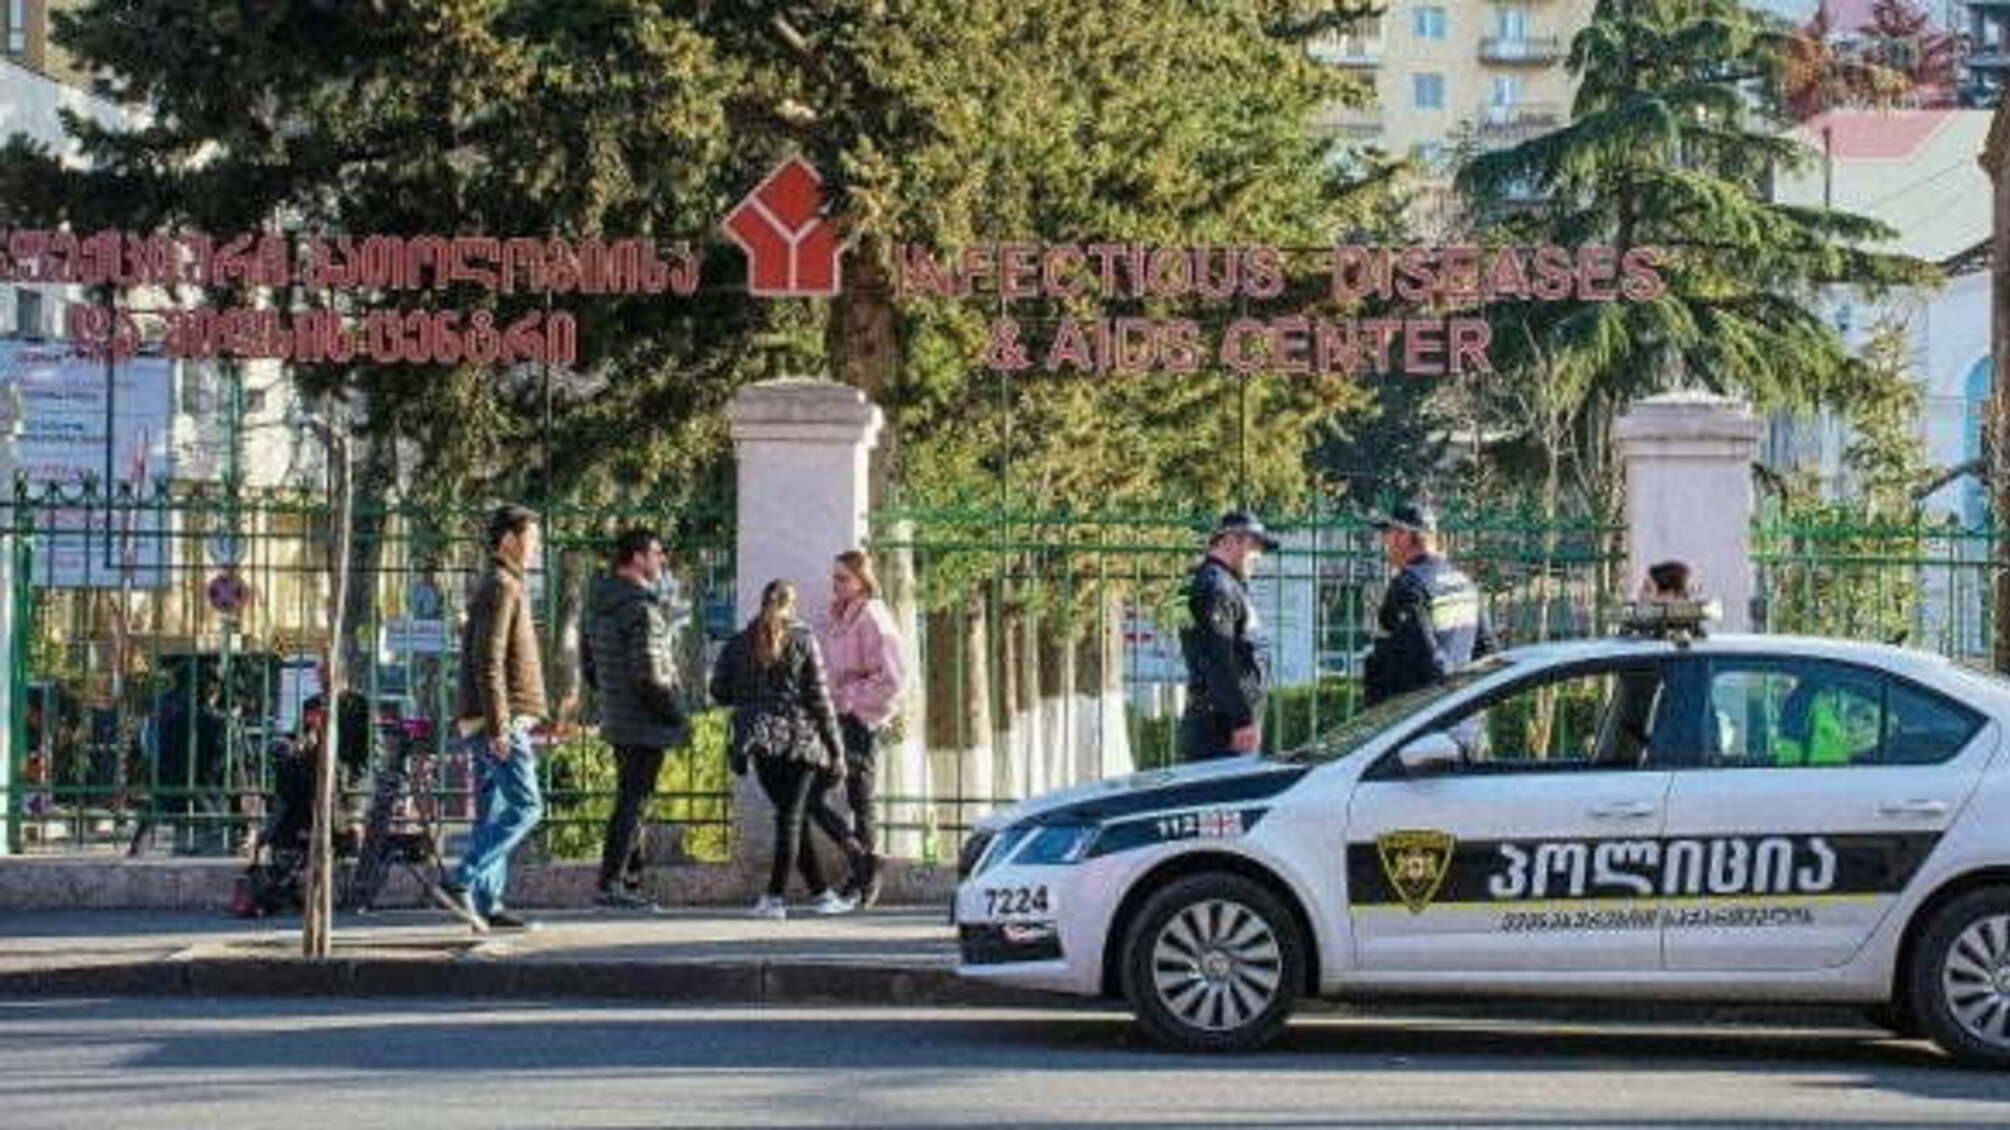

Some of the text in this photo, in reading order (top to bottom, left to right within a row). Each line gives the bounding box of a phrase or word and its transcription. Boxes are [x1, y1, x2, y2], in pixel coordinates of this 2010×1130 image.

[894, 242, 1666, 302] INFECTIOUS DISEASES
[367, 308, 577, 365] ცენტრი
[988, 315, 1494, 375] & AIDS CENTER
[1488, 836, 1837, 898] პოლიცია
[984, 884, 1049, 917] 7224
